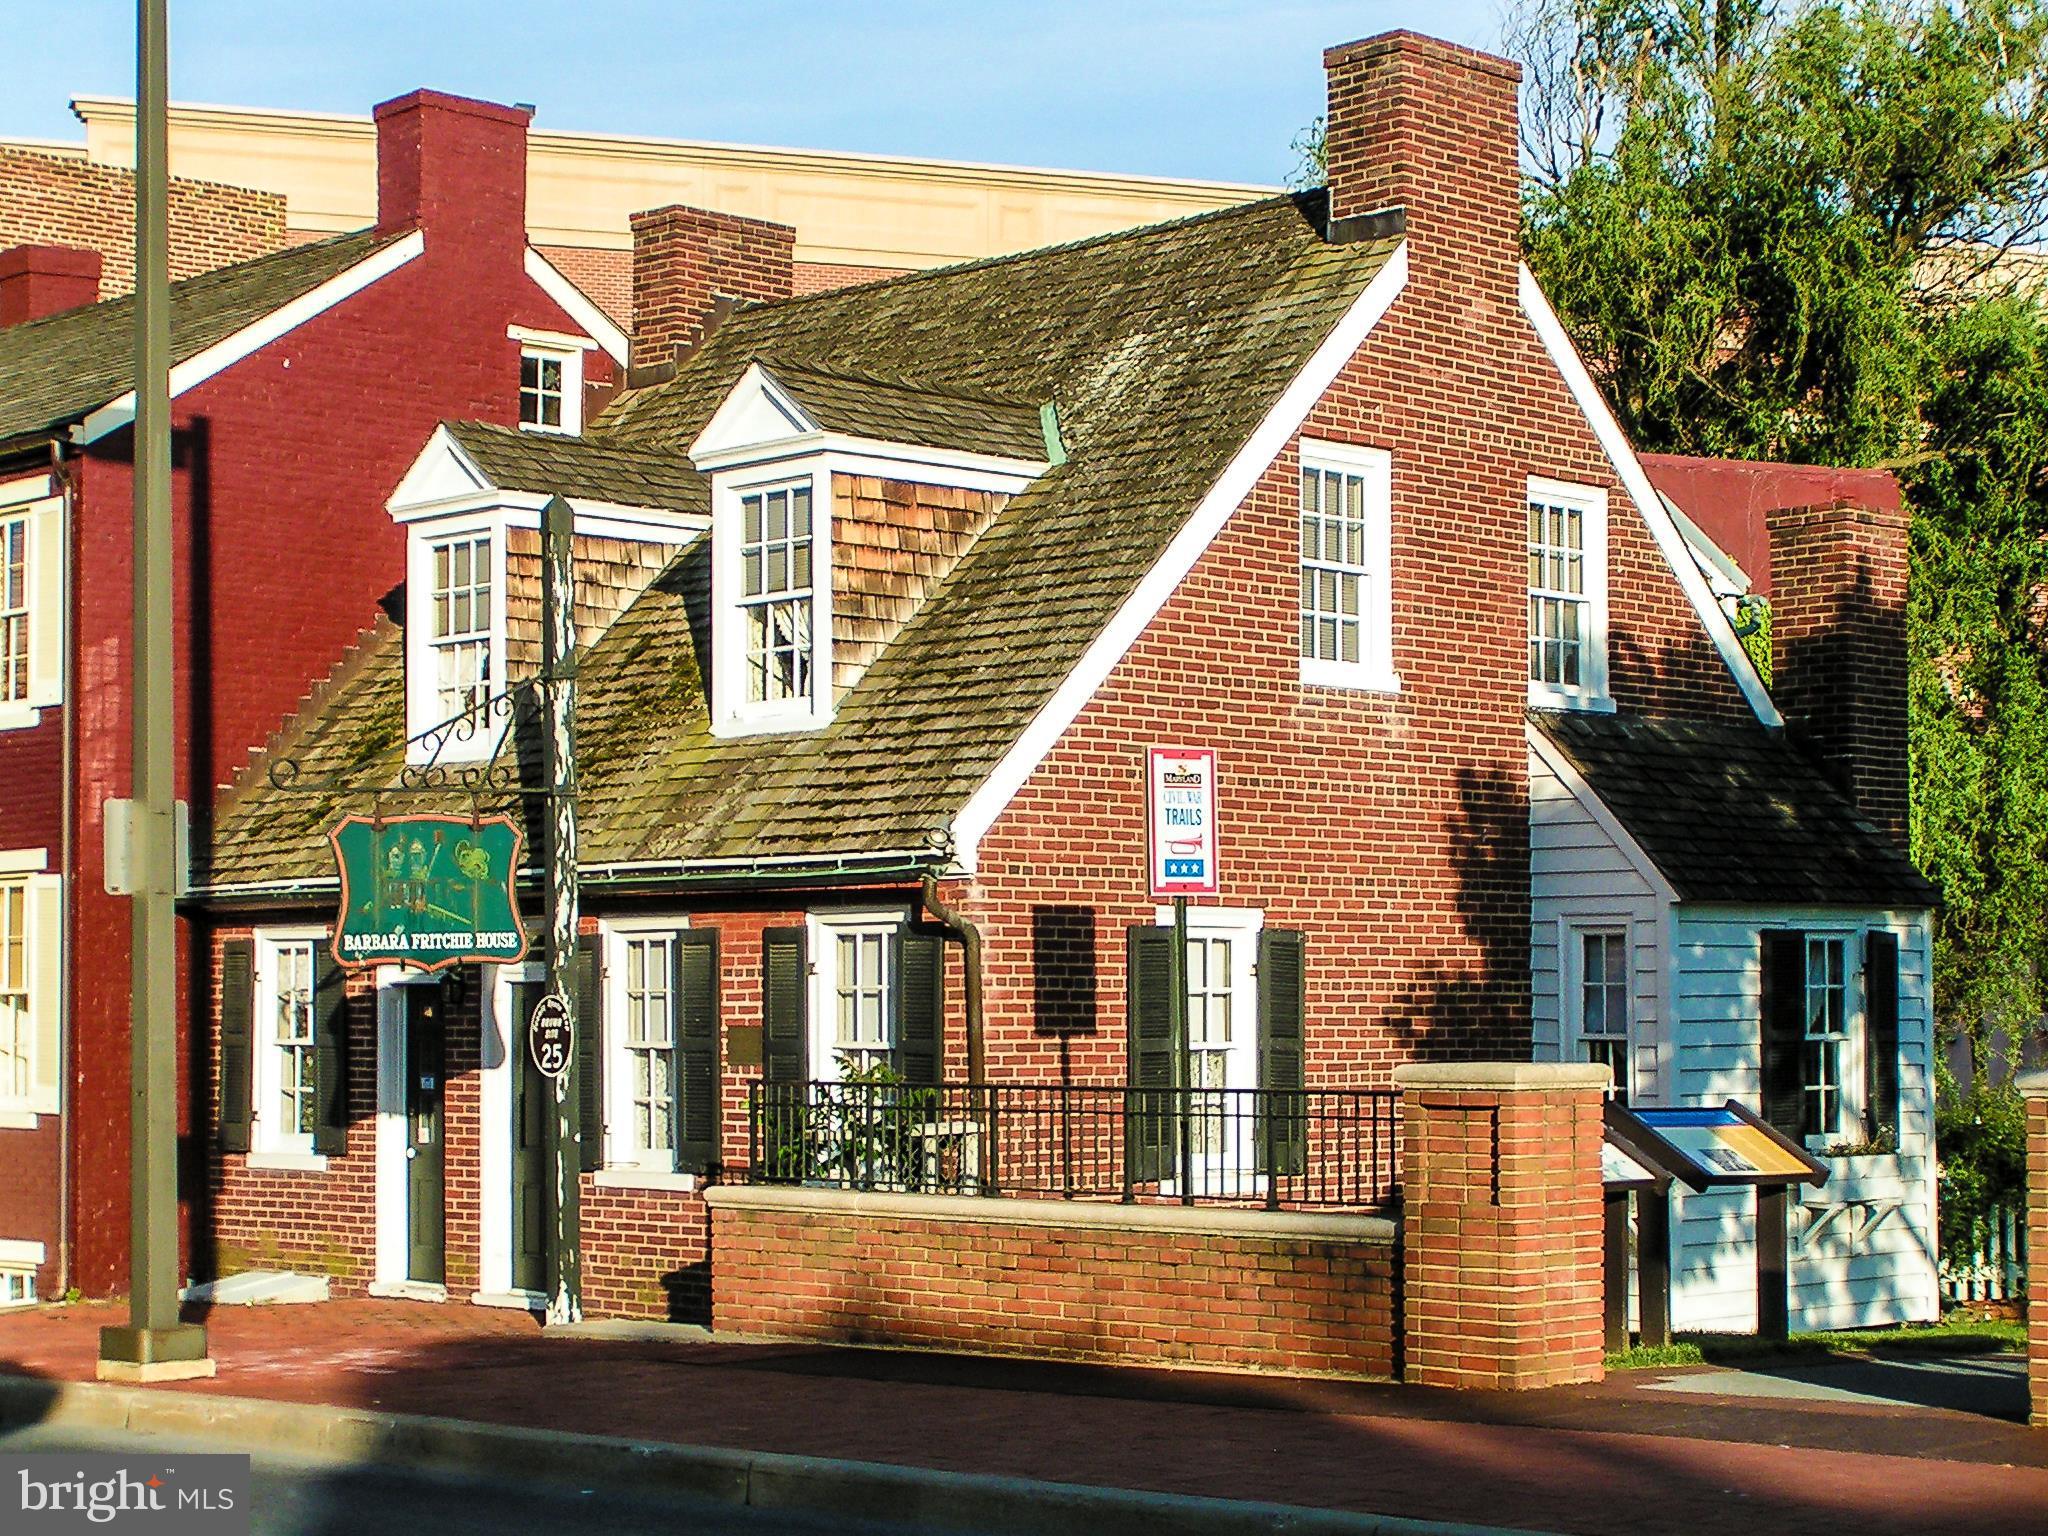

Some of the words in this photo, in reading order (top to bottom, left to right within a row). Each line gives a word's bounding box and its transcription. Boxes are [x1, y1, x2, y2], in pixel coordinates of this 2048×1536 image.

[1165, 773, 1201, 784] MARYLAND
[1187, 791, 1202, 804] WAR
[1165, 808, 1202, 826] TRAILS
[343, 933, 410, 951] BARBARA
[411, 932, 473, 950] FRITCHIE
[475, 931, 518, 949] HOUSE
[541, 1043, 563, 1069] 25
